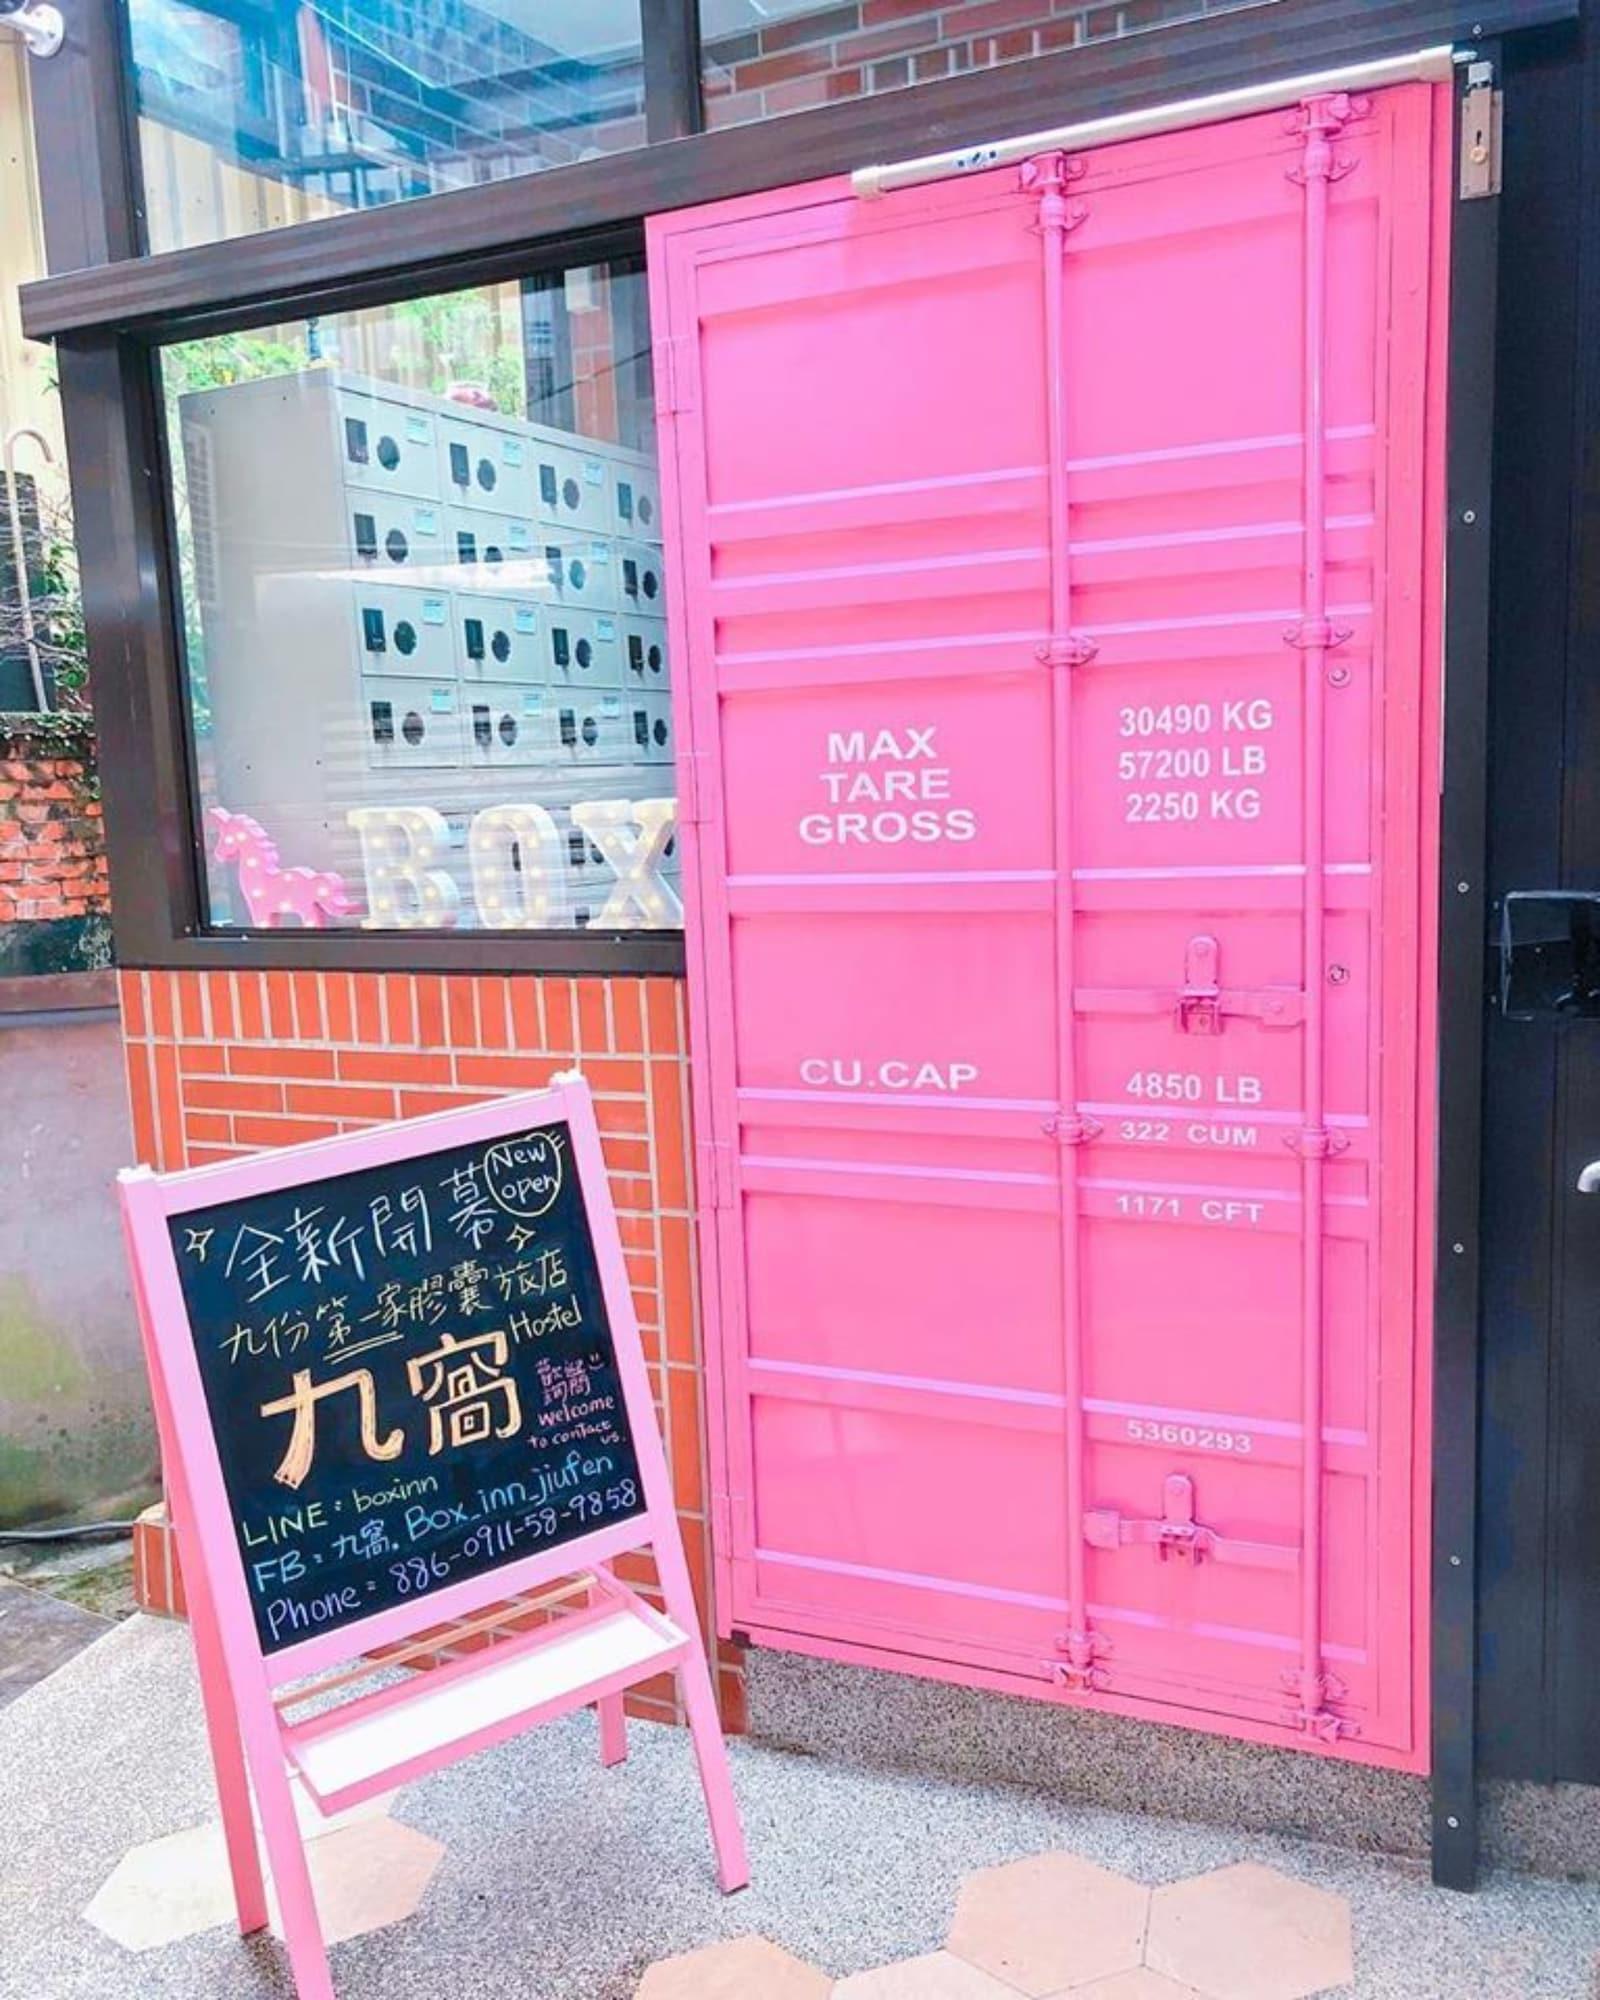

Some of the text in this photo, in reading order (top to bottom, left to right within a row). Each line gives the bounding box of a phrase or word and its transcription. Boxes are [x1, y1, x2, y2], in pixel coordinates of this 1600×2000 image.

[1119, 699, 1273, 737] 30490 KG
[828, 726, 938, 764] MAX
[1118, 745, 1267, 780] 57200 LB
[819, 768, 951, 804] TARE
[1125, 788, 1261, 823] 2250 KG
[799, 808, 976, 845] GROSS
[346, 798, 684, 930] BOX
[799, 1060, 979, 1091] CU.CAP
[1126, 1072, 1263, 1104] 4850 LB
[1119, 1121, 1258, 1146] 322 CUM
[491, 1142, 547, 1176] New
[501, 1174, 560, 1205] open
[1117, 1195, 1265, 1223] 1171 CFT
[224, 1161, 499, 1303] 全新開幕
[509, 1293, 583, 1345] Hostel
[259, 1330, 523, 1490] 九窩
[537, 1395, 616, 1427] welcome
[1126, 1419, 1251, 1454] 5360293
[352, 1475, 439, 1514] boxinn
[389, 1478, 638, 1595] 886-0911-58-9858
